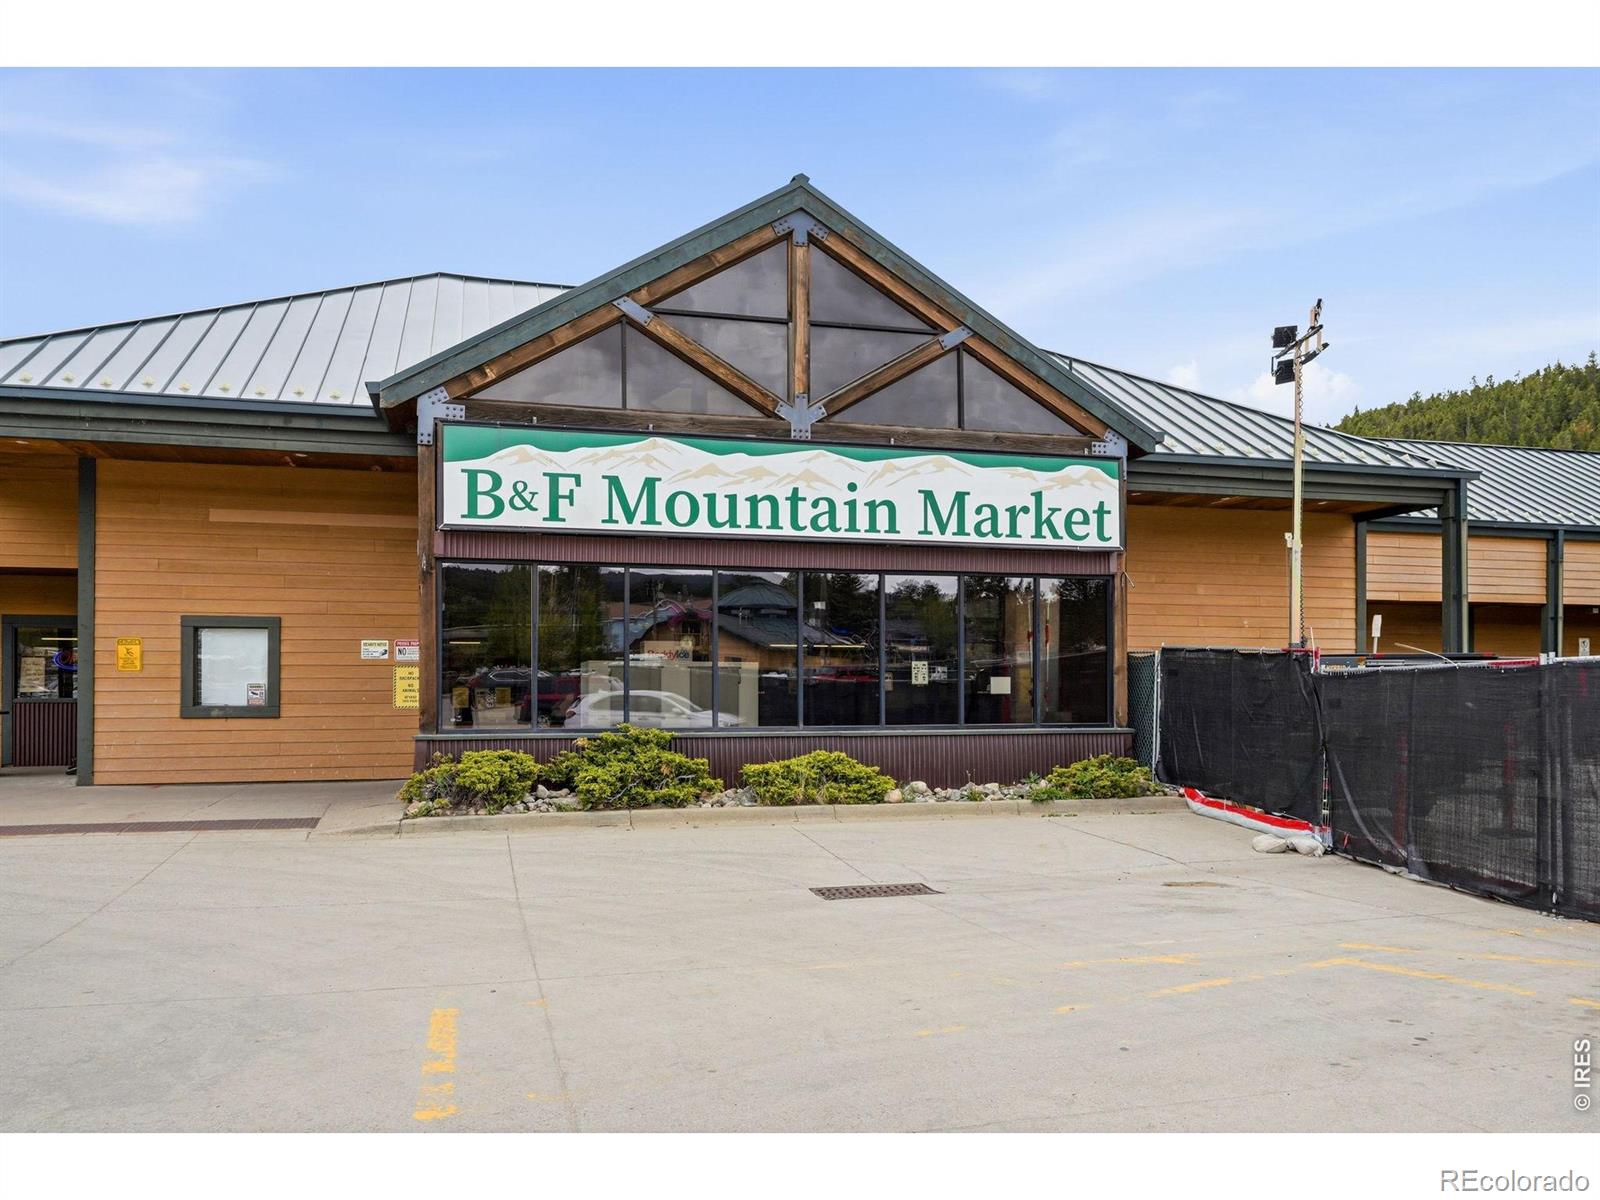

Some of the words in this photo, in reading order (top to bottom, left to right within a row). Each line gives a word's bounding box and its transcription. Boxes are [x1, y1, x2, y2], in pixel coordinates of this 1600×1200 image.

[461, 468, 581, 522] B&F
[602, 474, 900, 534] Mountain
[918, 489, 1113, 542] Market
